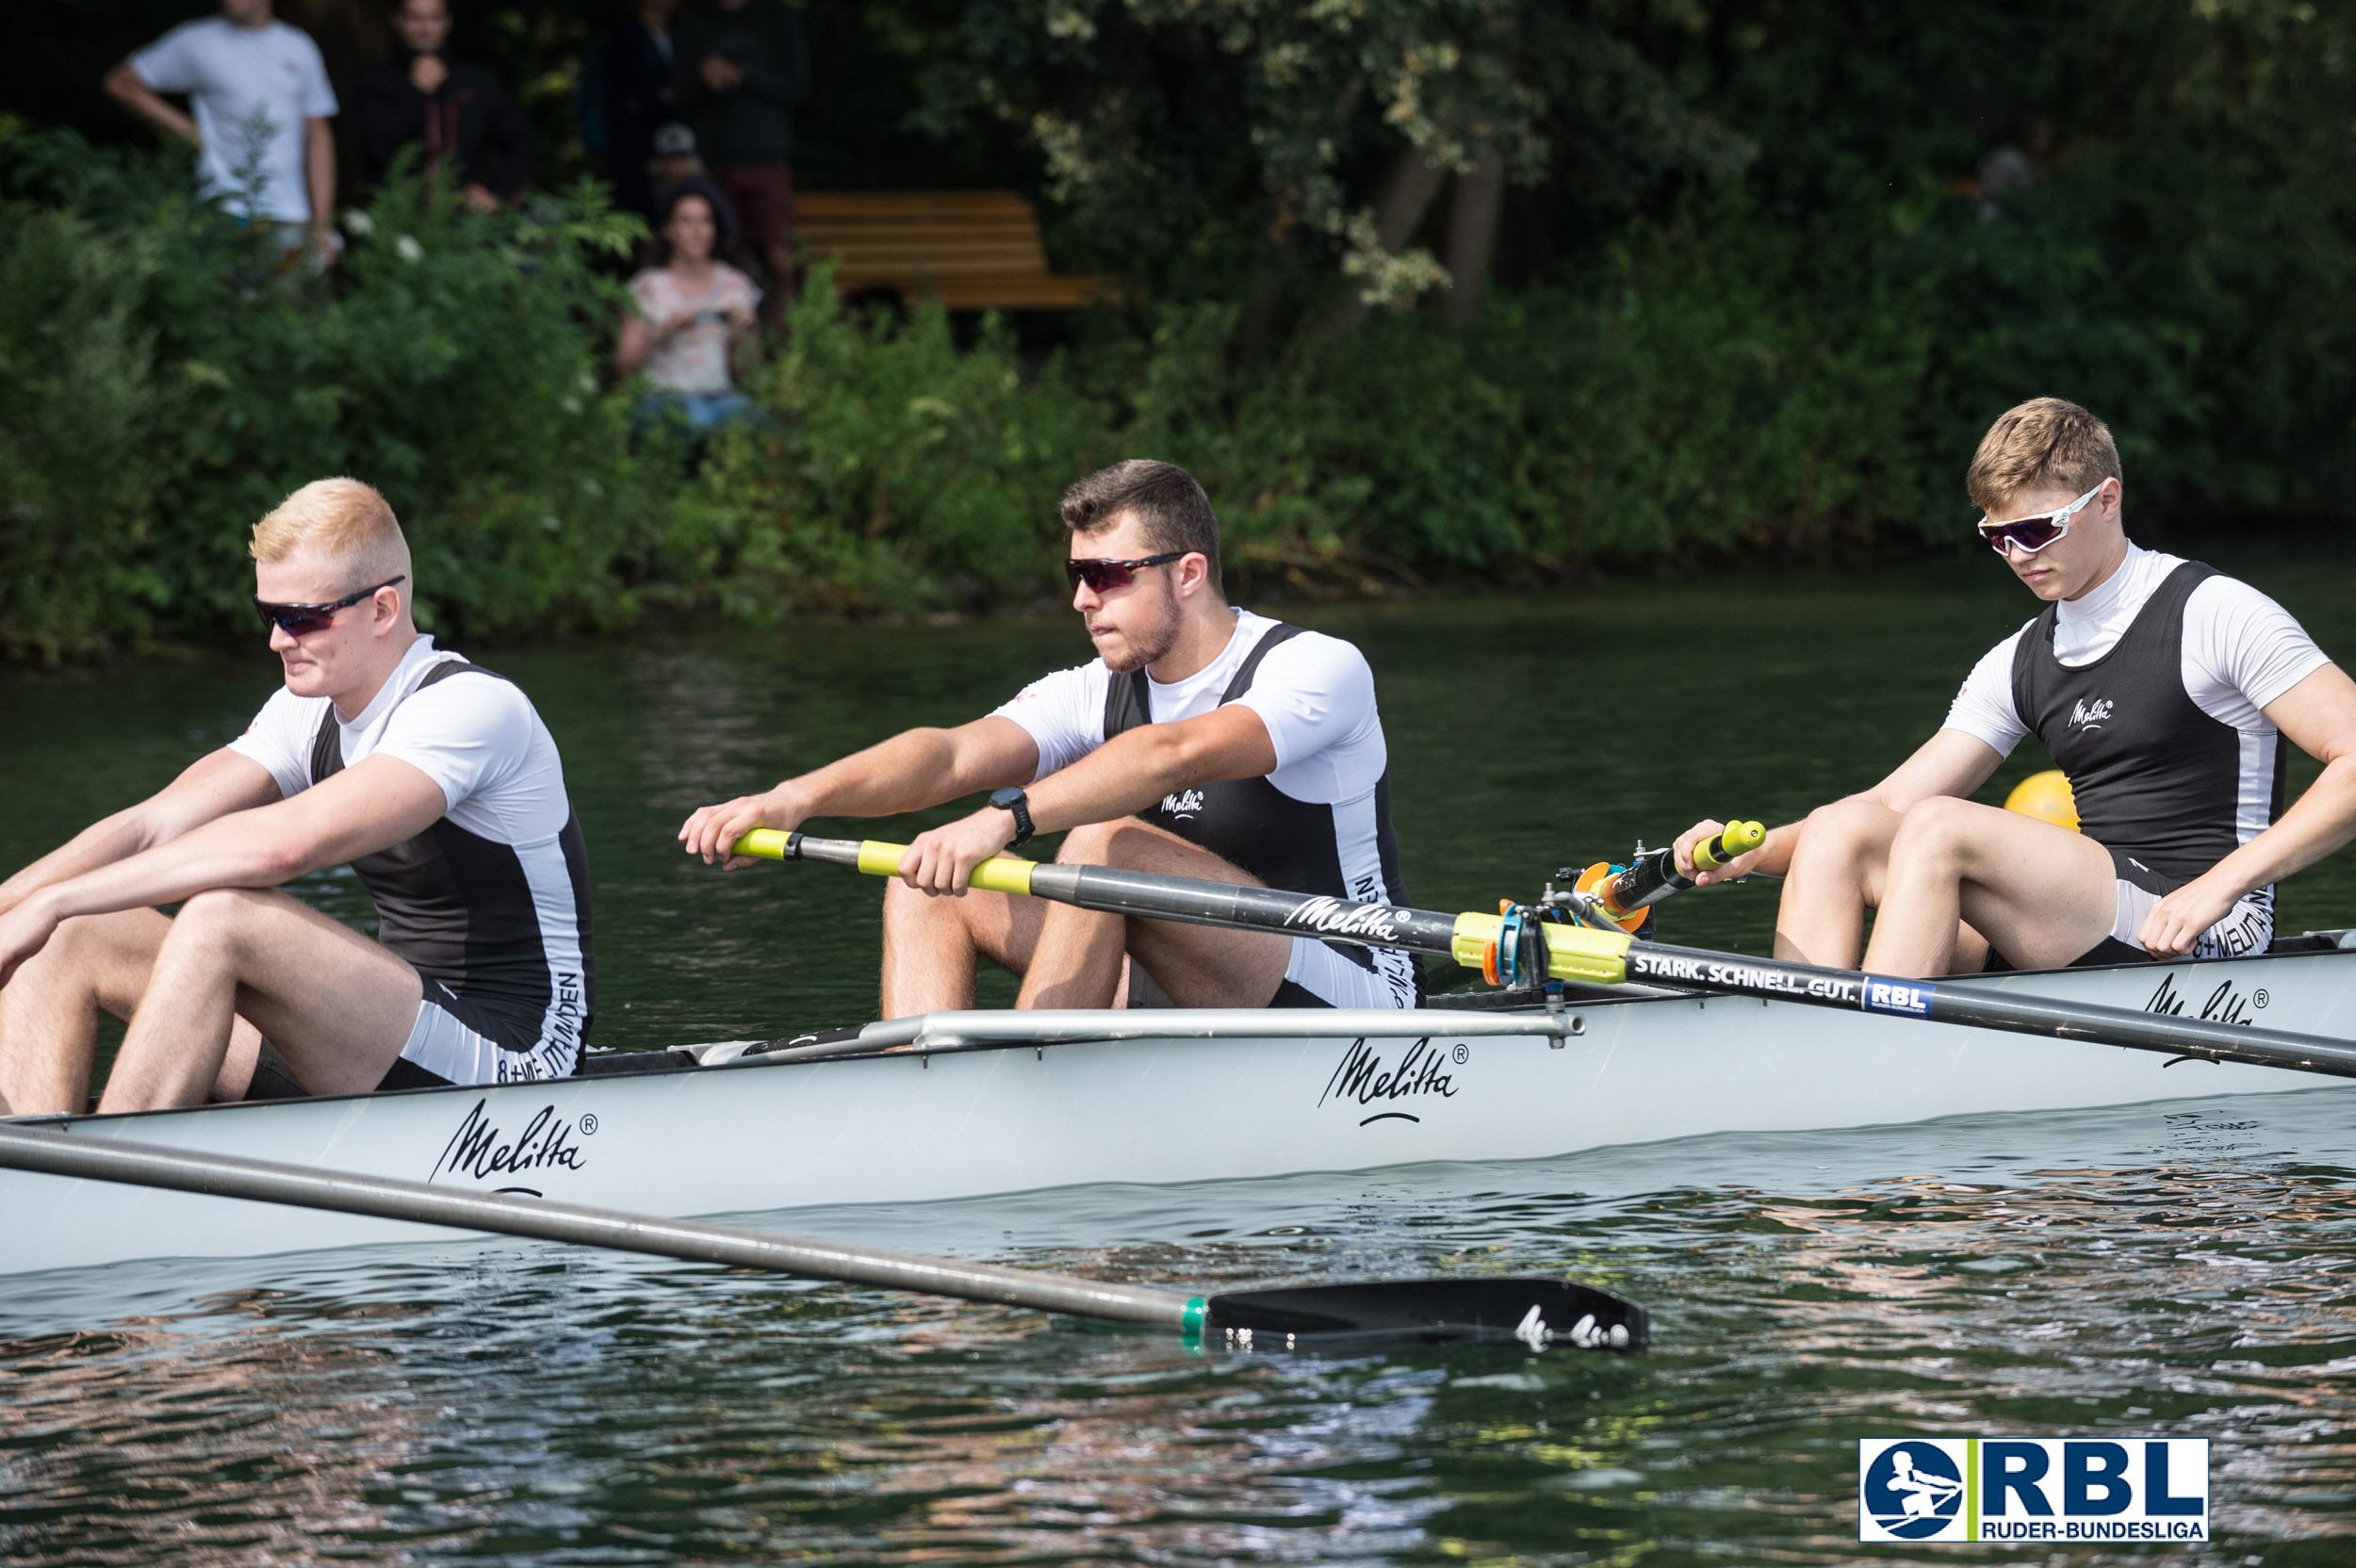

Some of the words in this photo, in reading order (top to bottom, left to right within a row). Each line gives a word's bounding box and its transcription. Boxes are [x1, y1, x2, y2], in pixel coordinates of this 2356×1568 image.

[1634, 955, 1706, 981] STARK.
[1708, 964, 1806, 995] SCHNELL.
[1807, 978, 1857, 1002] GUT.
[1871, 983, 1926, 1009] RBL
